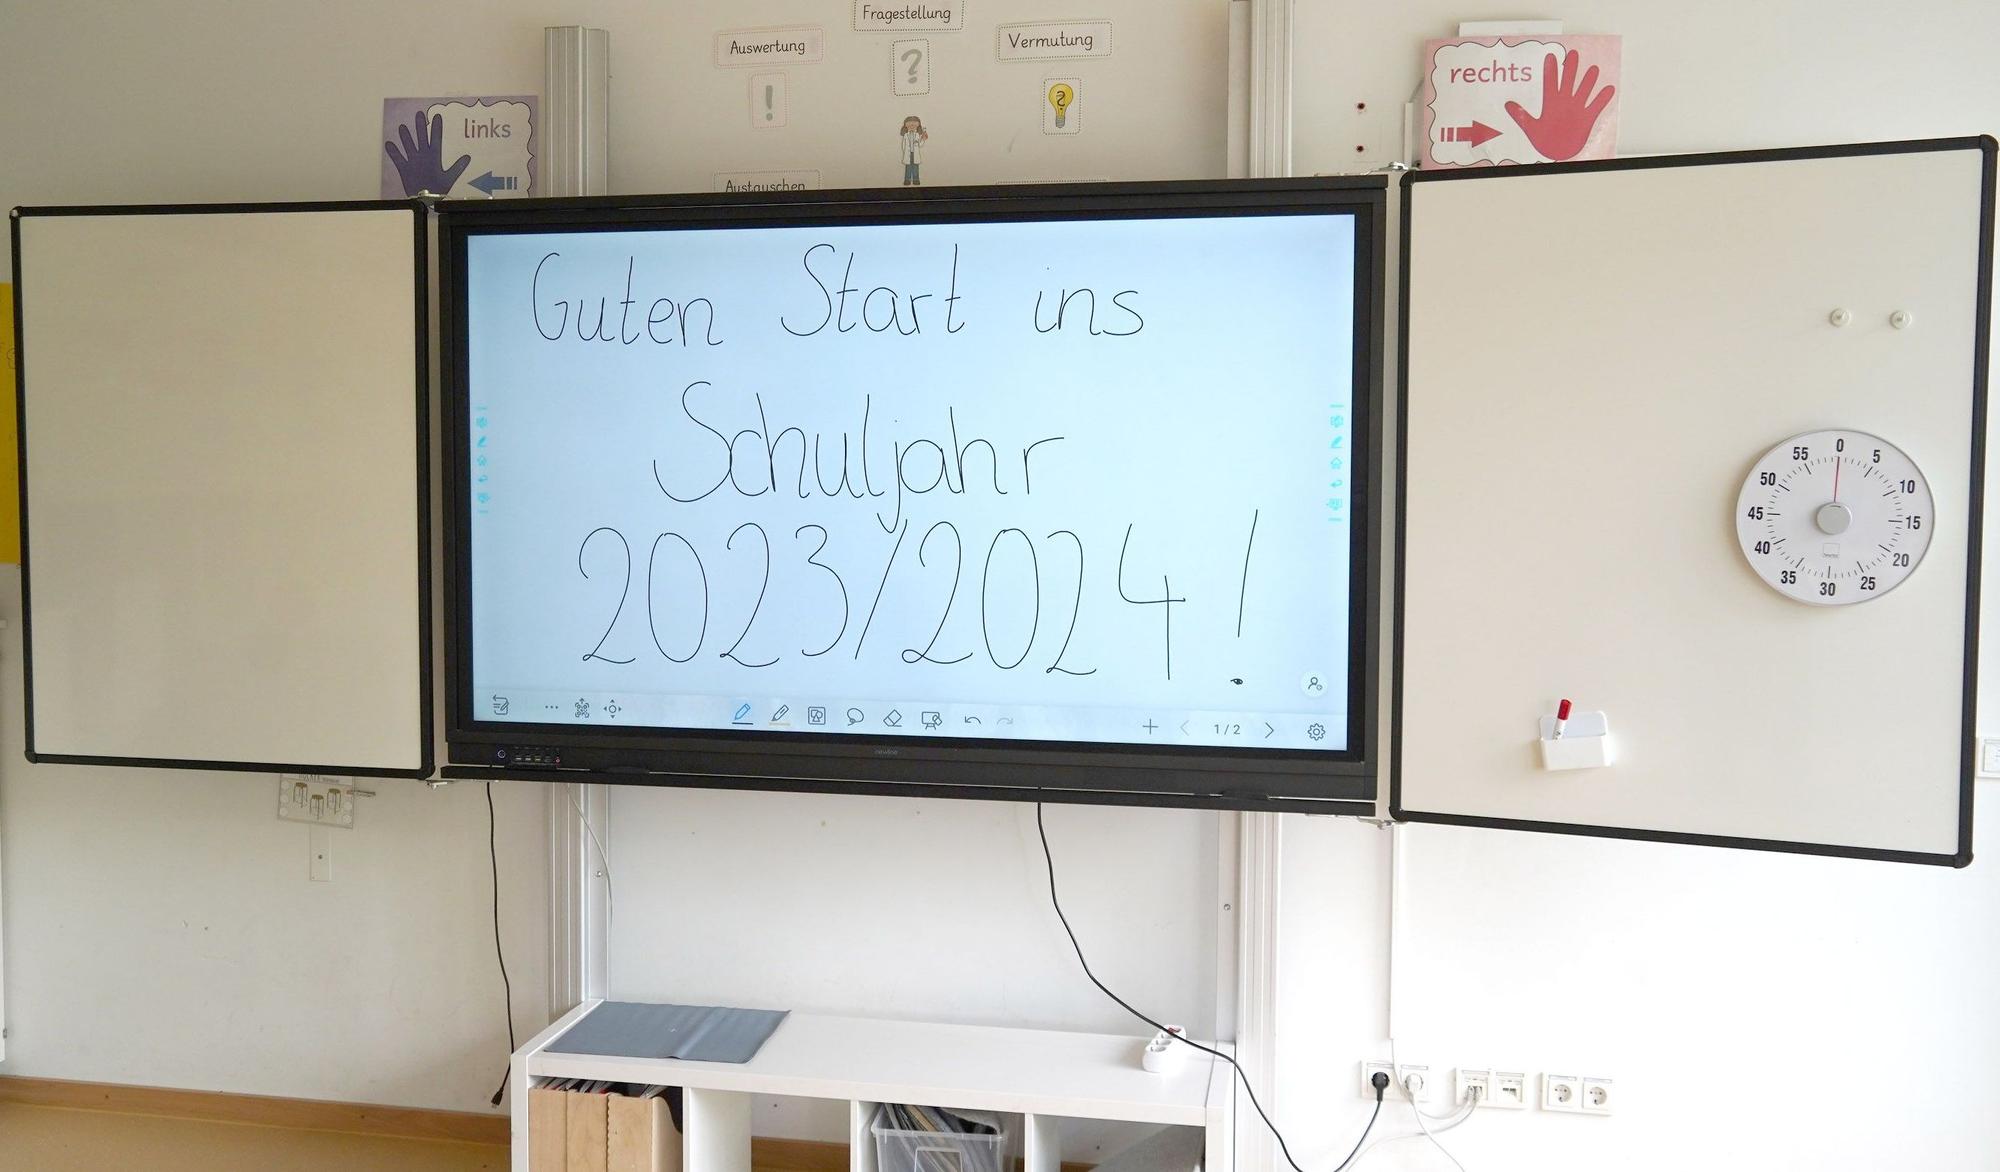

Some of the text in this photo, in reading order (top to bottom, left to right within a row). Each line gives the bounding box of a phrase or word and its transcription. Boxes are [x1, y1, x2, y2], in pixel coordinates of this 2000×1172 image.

[862, 4, 951, 25] Fragestellung
[730, 38, 806, 55] Auswertung
[1008, 31, 1094, 51] Vermutung
[900, 48, 923, 85] ?
[1450, 59, 1533, 84] rechts
[764, 84, 774, 121] !
[463, 117, 512, 140] links
[725, 178, 806, 193] Austauschen
[532, 243, 1144, 347] Guten Start ins
[1836, 438, 1844, 452] 0
[653, 380, 1066, 534] Schuljahr
[1792, 446, 1809, 461] 55
[1872, 449, 1881, 463] 5
[1760, 472, 1776, 486] 50
[1899, 479, 1915, 494] 10
[1747, 506, 1764, 521] 45
[1905, 515, 1921, 530] 15
[1754, 541, 1771, 555] 40
[1892, 553, 1909, 567] 20
[1780, 570, 1797, 585] 35
[1860, 576, 1876, 591] 25
[1819, 582, 1836, 596] 30
